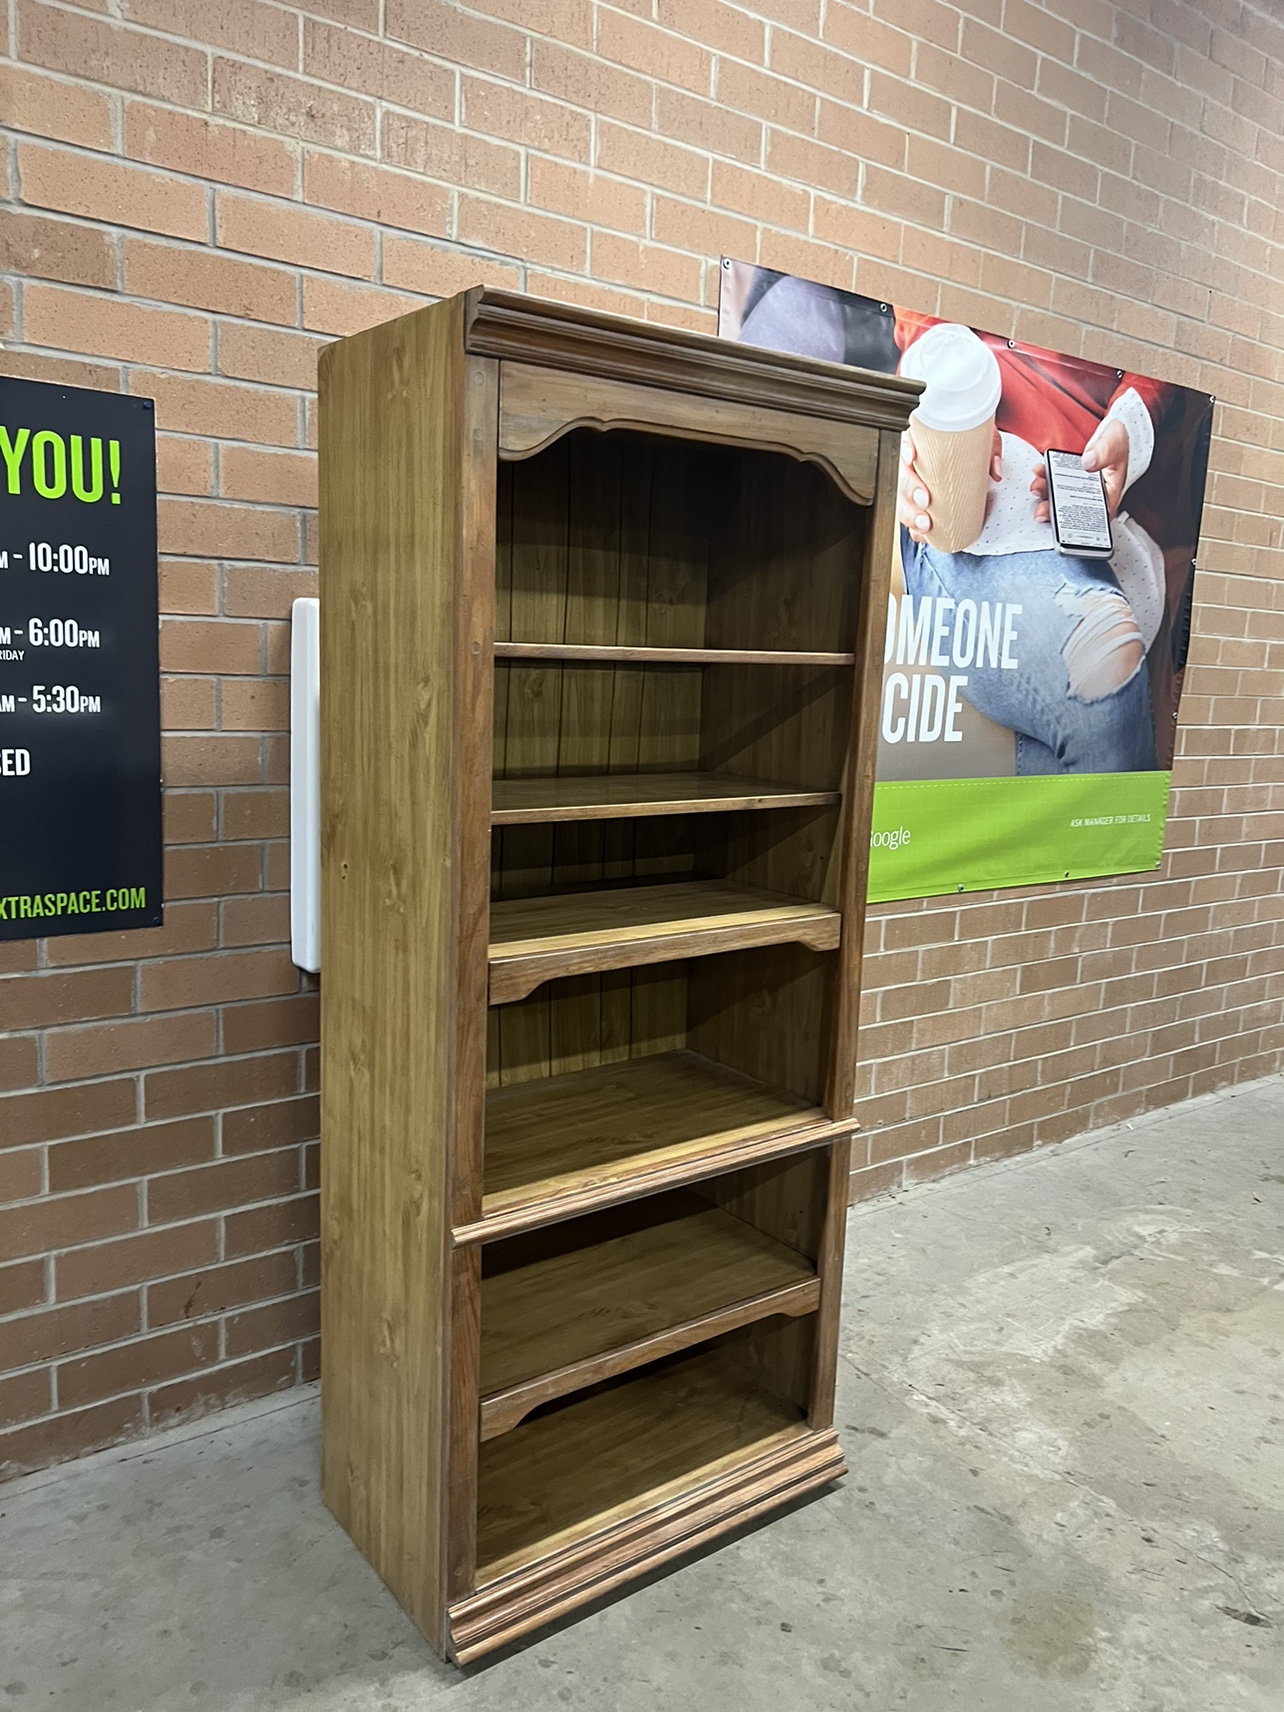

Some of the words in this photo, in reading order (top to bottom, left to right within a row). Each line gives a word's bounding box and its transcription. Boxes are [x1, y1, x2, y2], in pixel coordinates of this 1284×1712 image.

[0, 425, 121, 505] YOU!
[29, 542, 110, 576] 10:00PM
[28, 617, 100, 648] 6:00PM
[32, 685, 101, 713] 5:30PM
[881, 672, 968, 744] CIDE
[0, 748, 31, 777] ED
[1070, 819, 1083, 827] ASK
[1085, 816, 1113, 826] MANAGER
[1114, 815, 1127, 824] FOR
[1128, 814, 1151, 823] DETAILS
[870, 825, 911, 850] oogle
